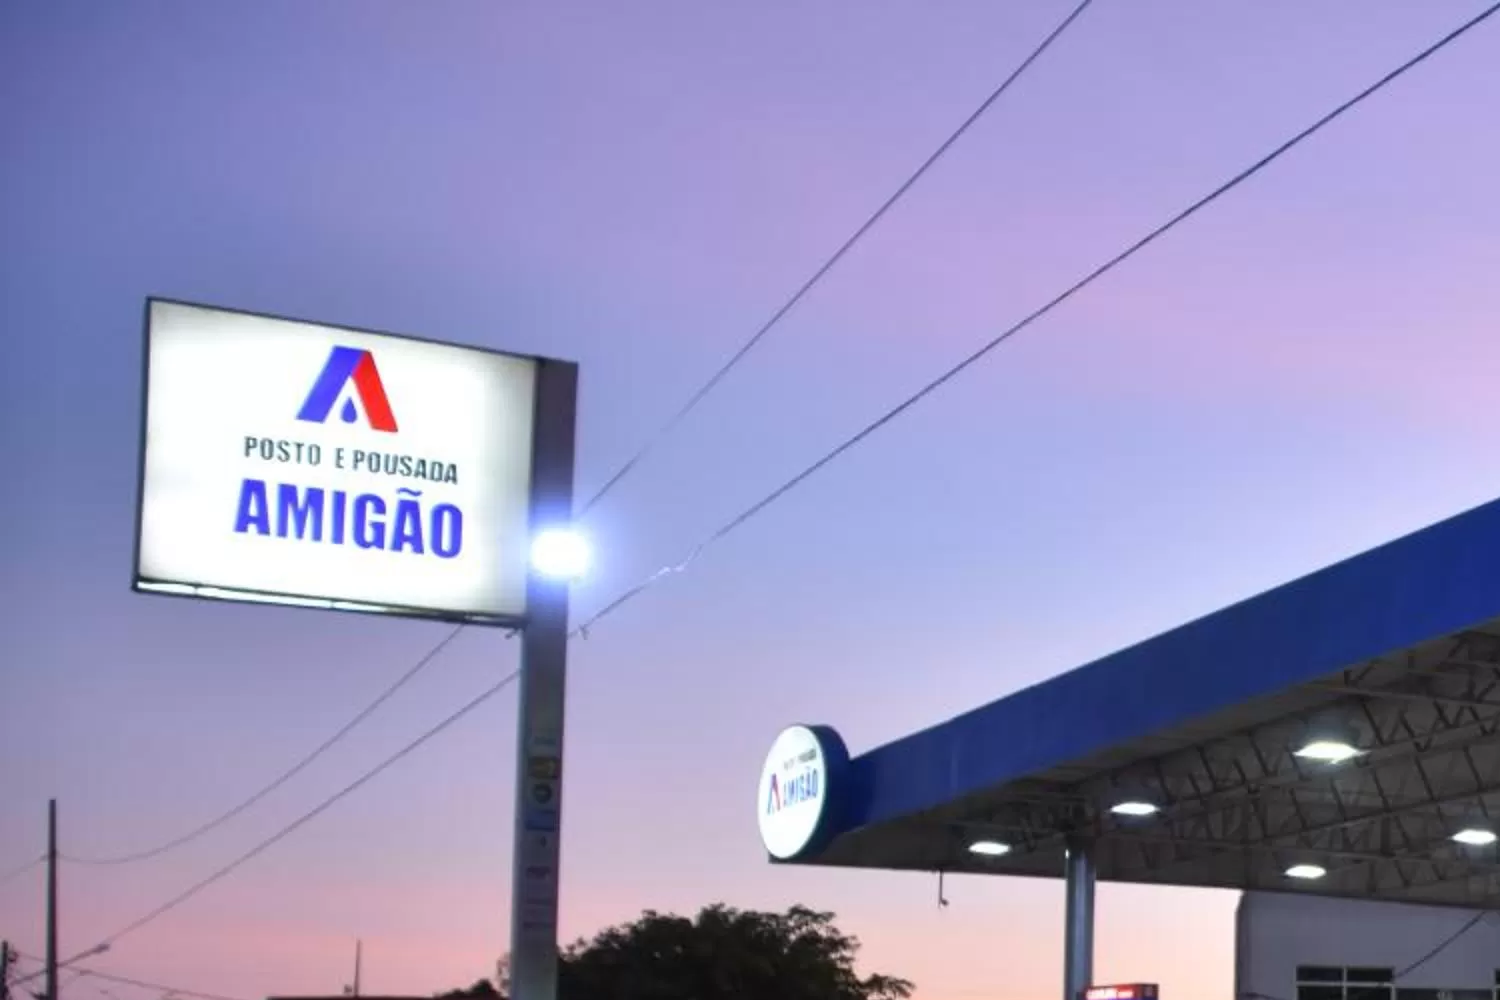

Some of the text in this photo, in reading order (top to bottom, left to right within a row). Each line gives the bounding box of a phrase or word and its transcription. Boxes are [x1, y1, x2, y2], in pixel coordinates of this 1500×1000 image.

[244, 435, 458, 485] POSTO E POUSADA
[234, 478, 463, 559] AMIGÃO
